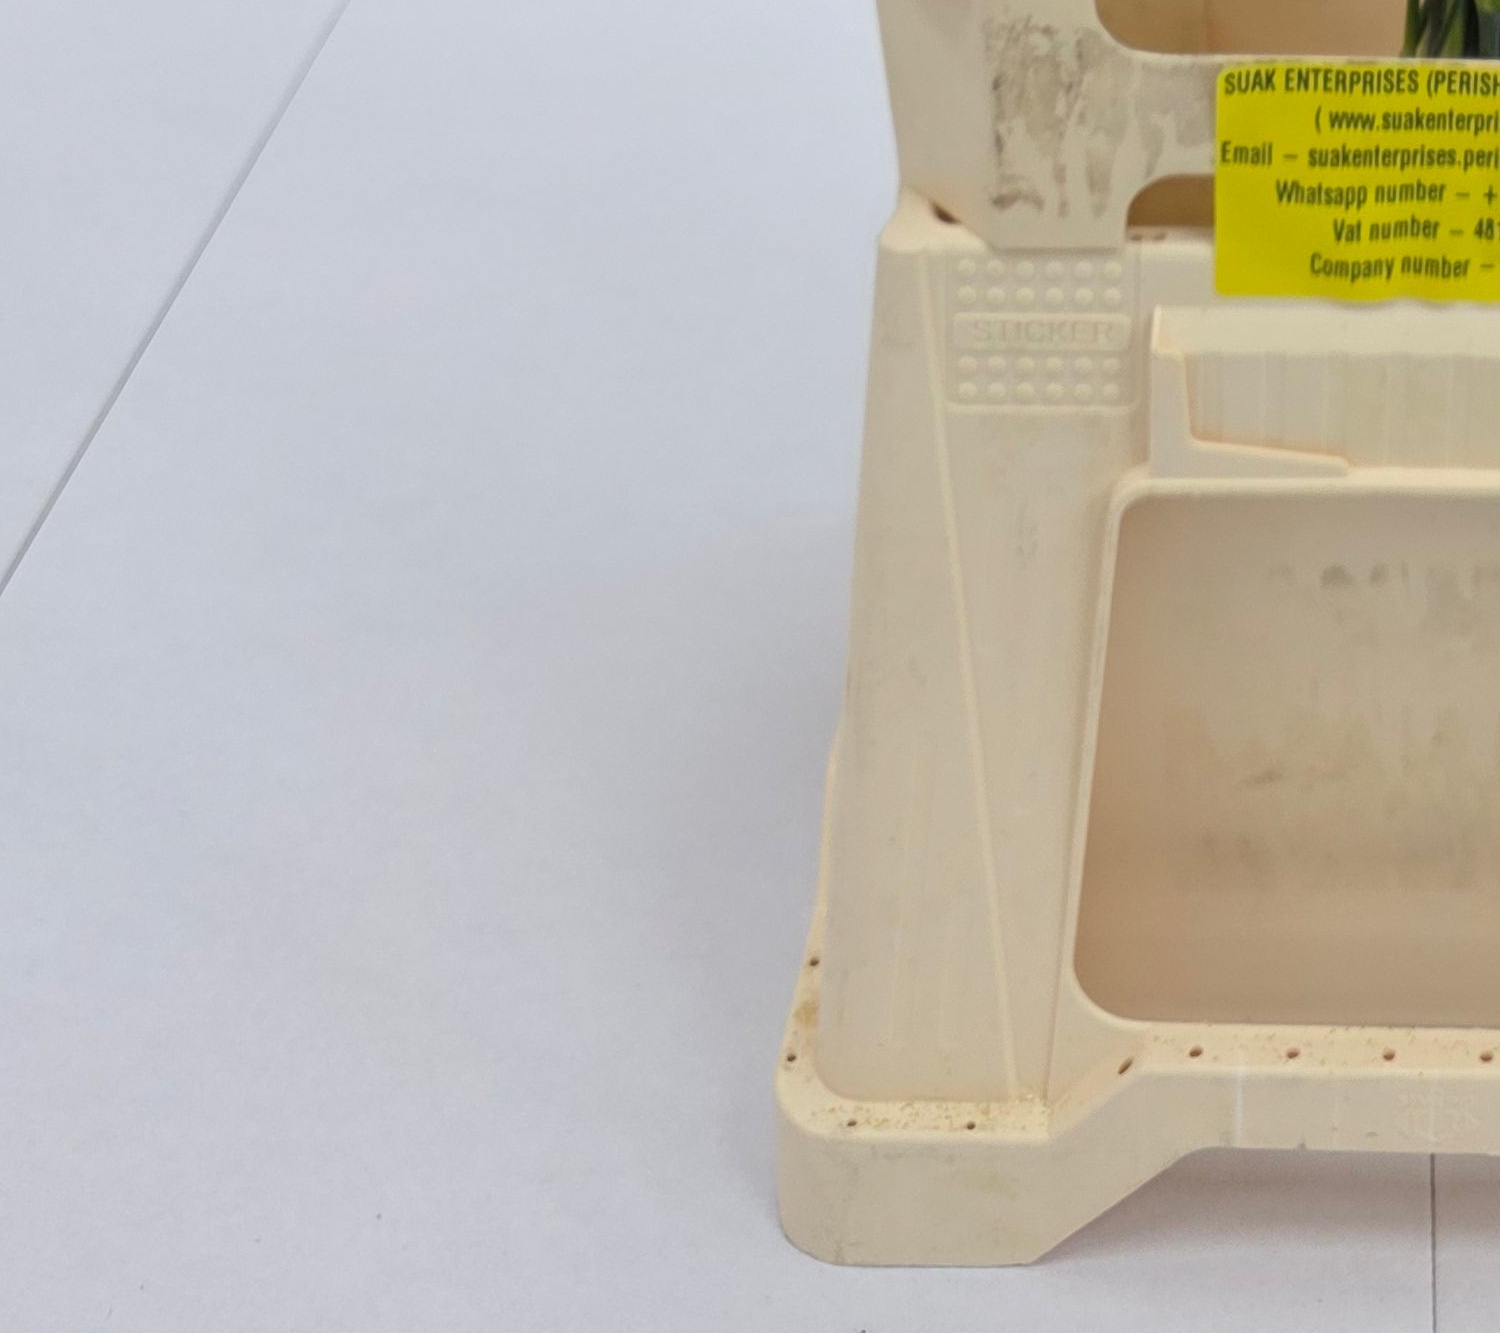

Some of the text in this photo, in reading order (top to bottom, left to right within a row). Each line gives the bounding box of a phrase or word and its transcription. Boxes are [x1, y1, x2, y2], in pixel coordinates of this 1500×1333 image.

[1224, 68, 1276, 95] SUAK
[1284, 68, 1419, 95] ENTERPRISES
[1220, 140, 1273, 166] Email
[1276, 179, 1368, 210] Whatsapp
[1374, 179, 1446, 203] number
[1333, 219, 1362, 243] Vat
[1369, 216, 1440, 241] number
[1310, 252, 1395, 284] Company
[1400, 255, 1470, 279] number
[972, 319, 1115, 344] STICKER
